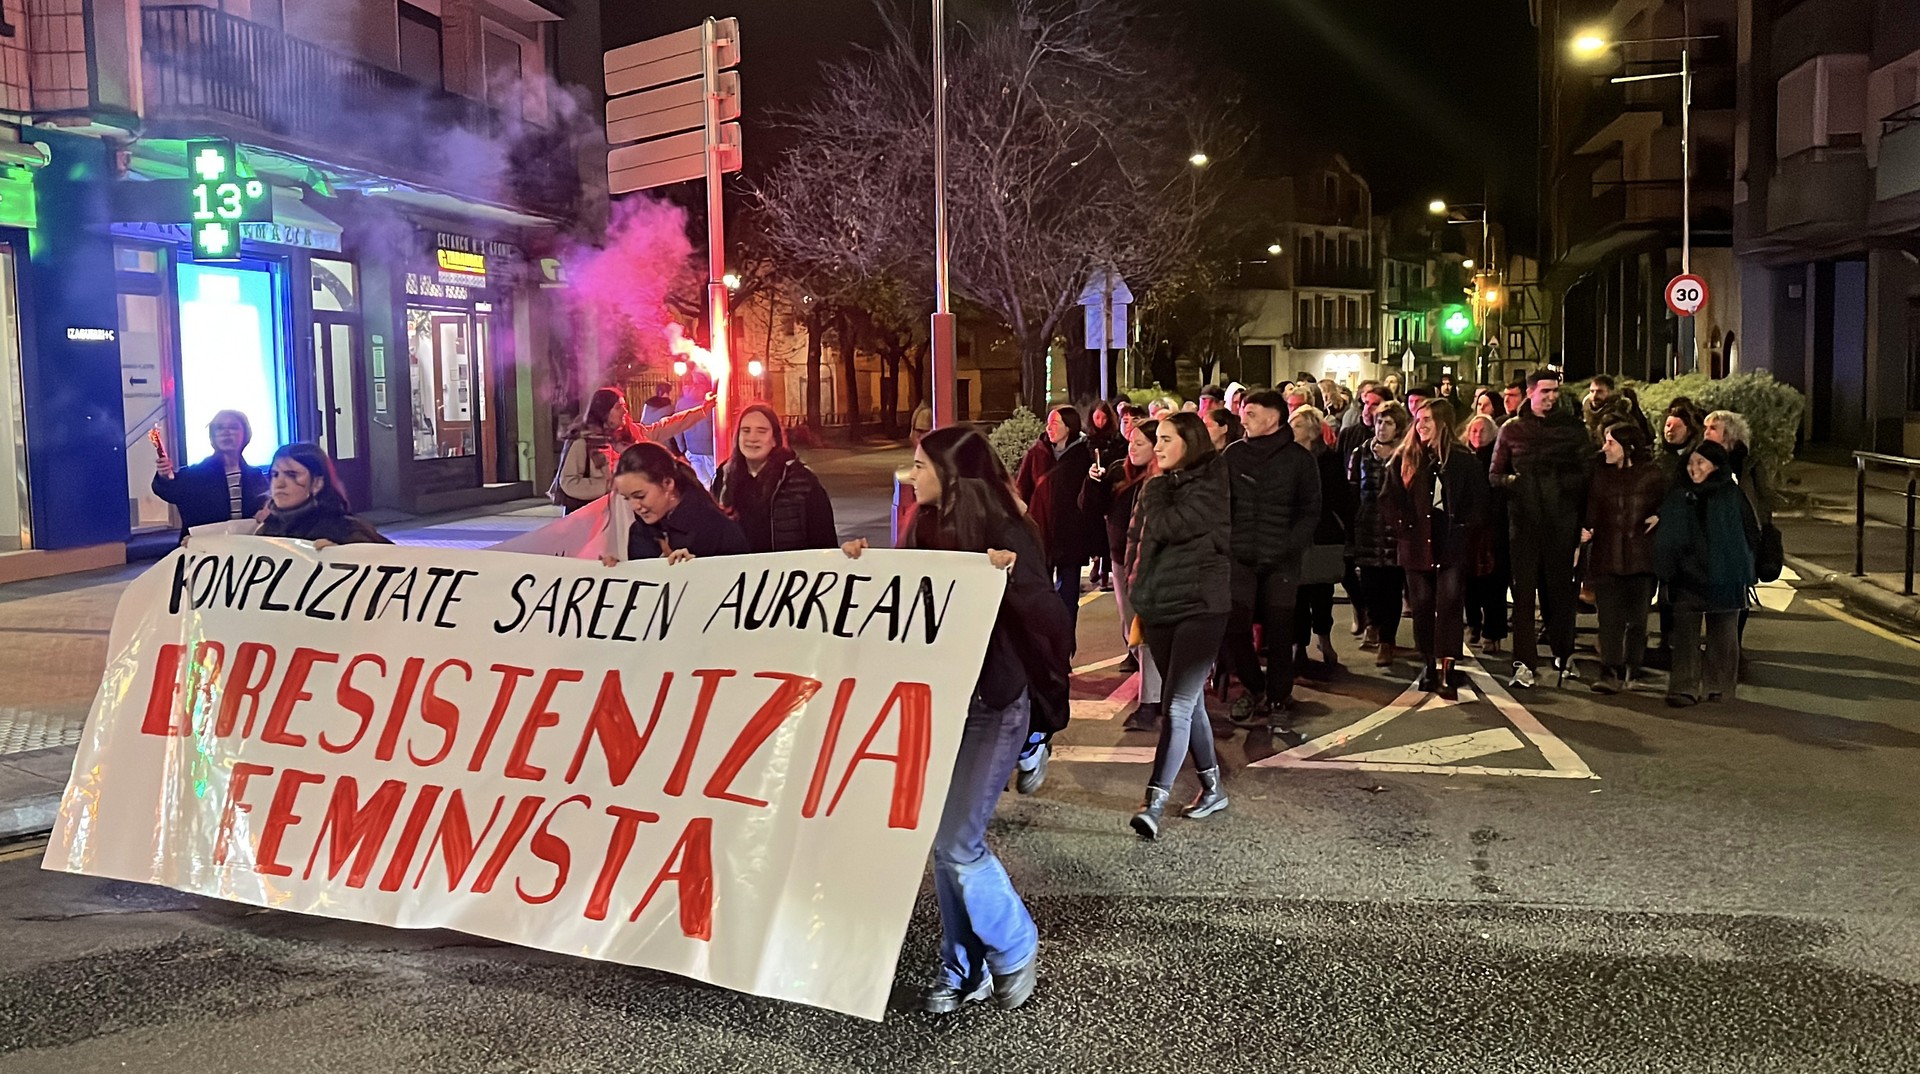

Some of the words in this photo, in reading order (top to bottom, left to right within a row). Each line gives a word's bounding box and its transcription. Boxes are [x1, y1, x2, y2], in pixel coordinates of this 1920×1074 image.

[1676, 288, 1699, 302] 30
[168, 553, 479, 629] KONPLIZITATE
[493, 573, 688, 642] SAREEN
[703, 569, 956, 644] AURREAN
[141, 640, 931, 830] ERRESISTENTZIA
[213, 762, 713, 942] FEMINISTA
